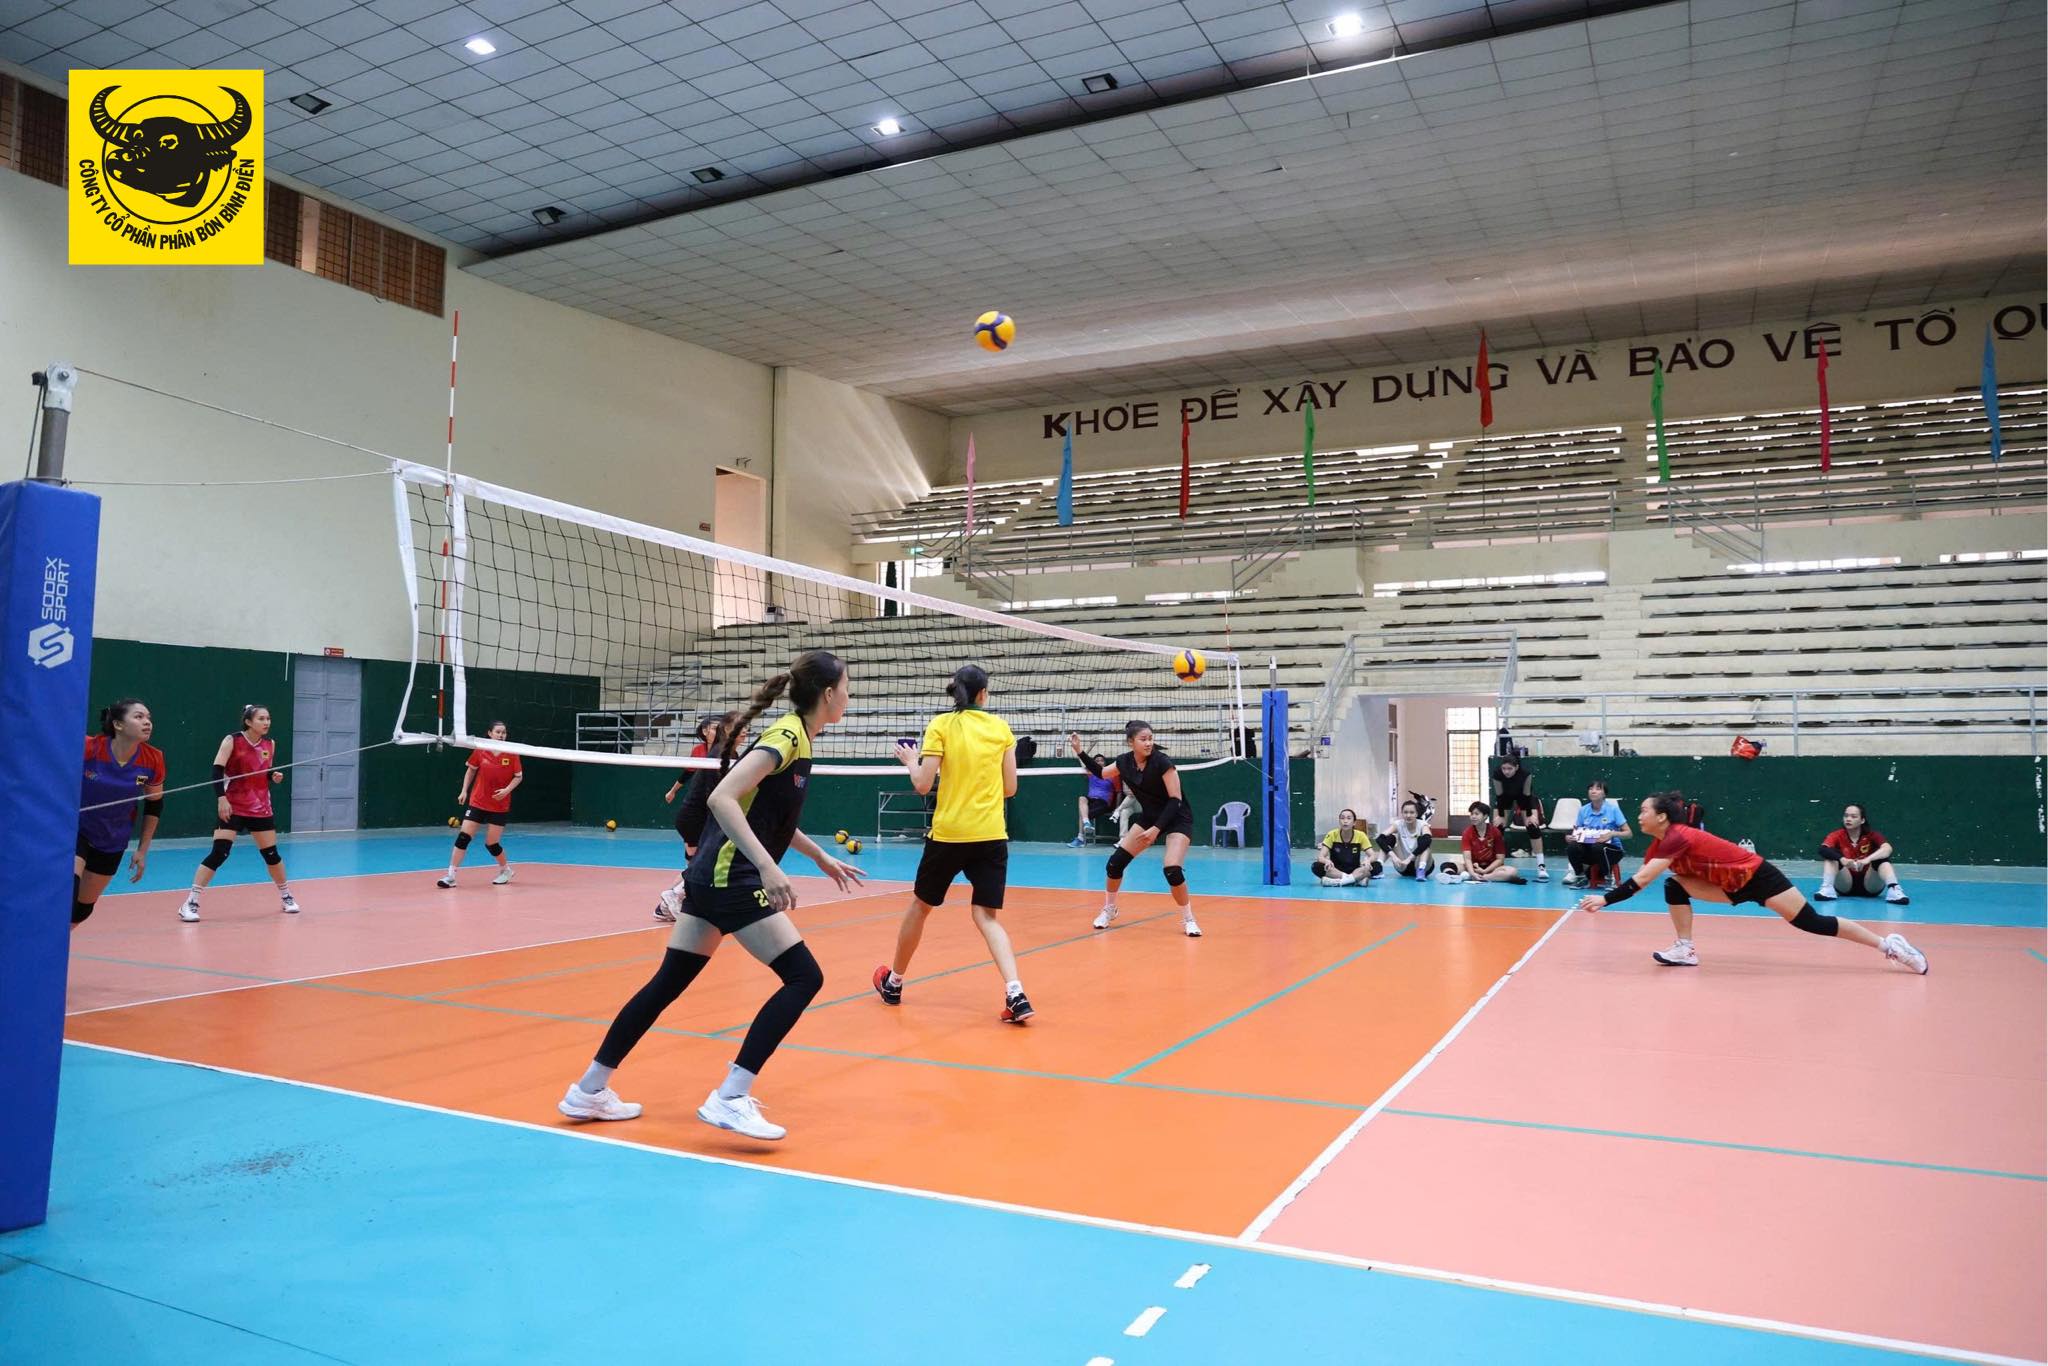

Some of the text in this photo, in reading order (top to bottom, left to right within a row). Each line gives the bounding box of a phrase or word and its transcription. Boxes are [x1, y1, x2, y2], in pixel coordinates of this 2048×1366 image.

[1263, 380, 1348, 415] XÂY
[1536, 349, 1598, 385] VÀ
[1874, 307, 1956, 350] TỔ
[1993, 302, 2048, 342] Q
[41, 556, 58, 620] SODEX
[54, 558, 70, 622] SPORT
